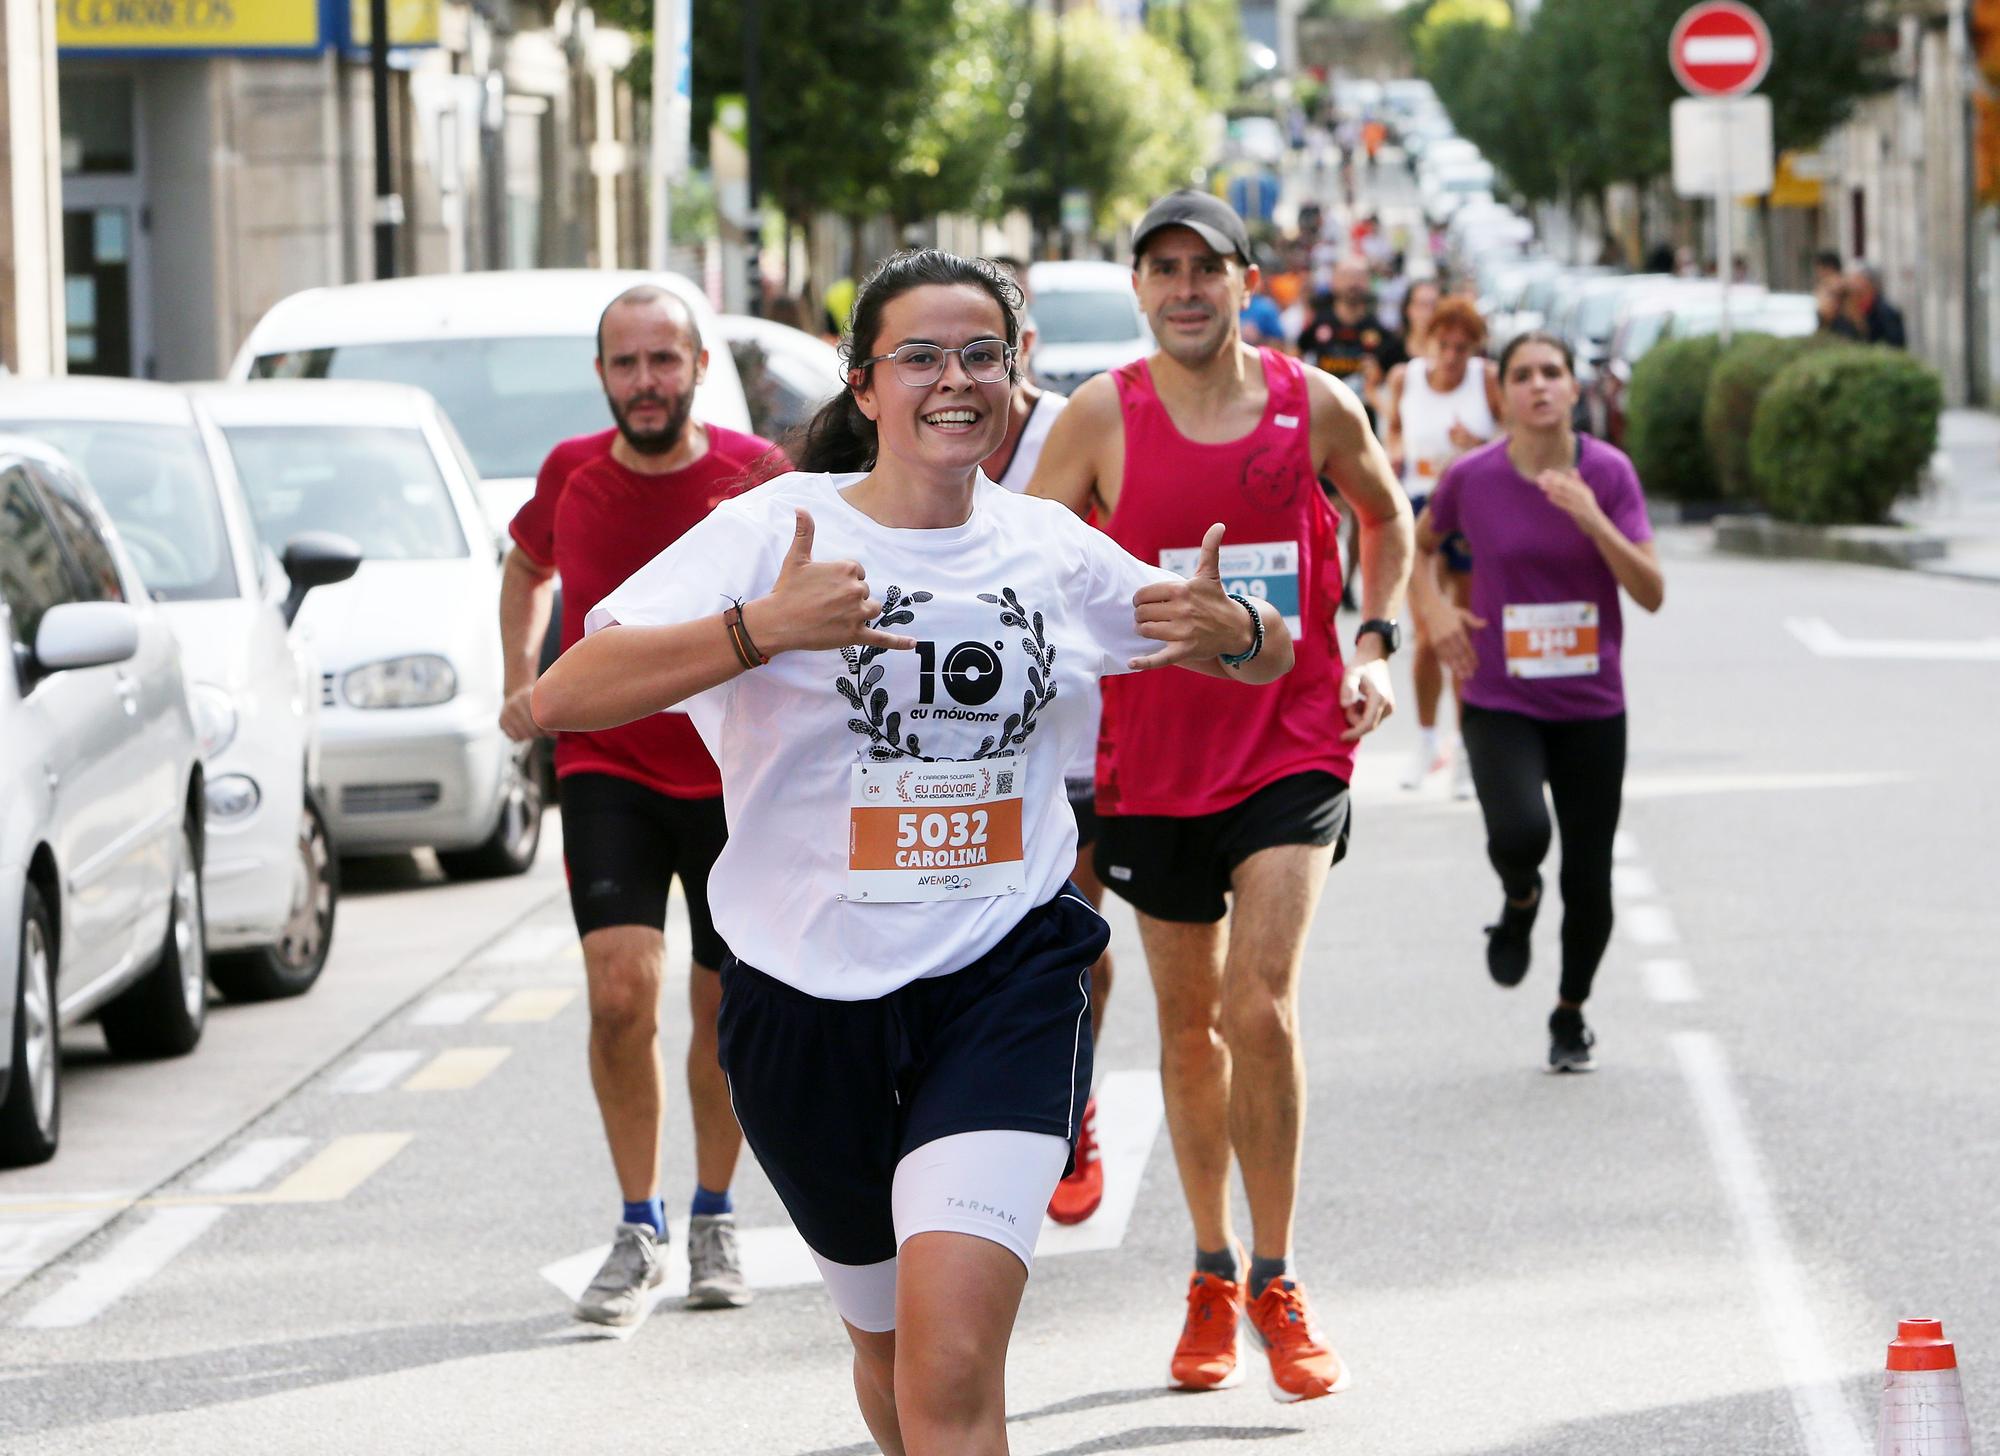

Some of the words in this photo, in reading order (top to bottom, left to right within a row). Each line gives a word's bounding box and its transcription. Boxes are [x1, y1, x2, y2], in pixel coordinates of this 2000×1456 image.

[910, 709, 928, 719] eu
[868, 785, 880, 794] 5K
[914, 784, 929, 794] EU
[932, 781, 977, 794] MÓVOME
[896, 809, 989, 848] 5032
[895, 846, 987, 868] CAROLINA
[918, 874, 960, 885] AVEMPO
[946, 1197, 1017, 1225] TARMAK
